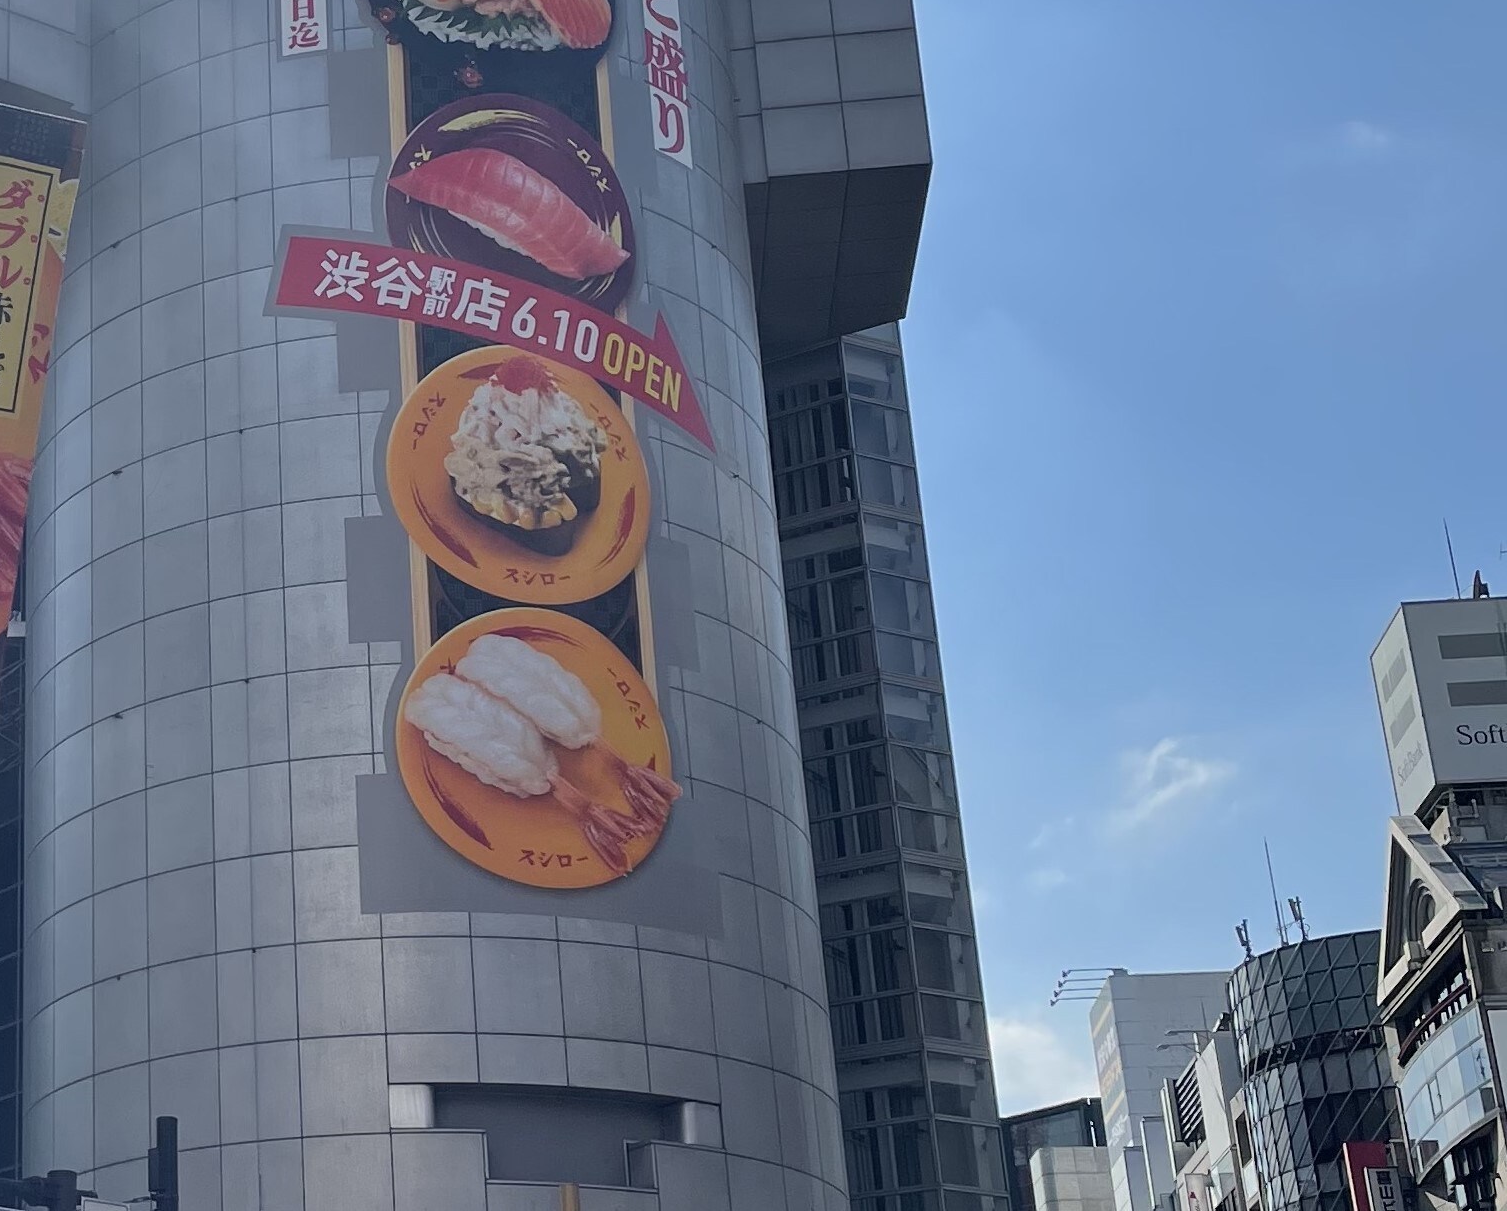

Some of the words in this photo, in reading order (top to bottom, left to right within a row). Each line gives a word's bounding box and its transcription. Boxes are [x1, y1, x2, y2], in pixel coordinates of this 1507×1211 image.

[602, 332, 682, 413] OPEN
[502, 567, 571, 586] スシロー
[518, 848, 589, 868] スシロー
